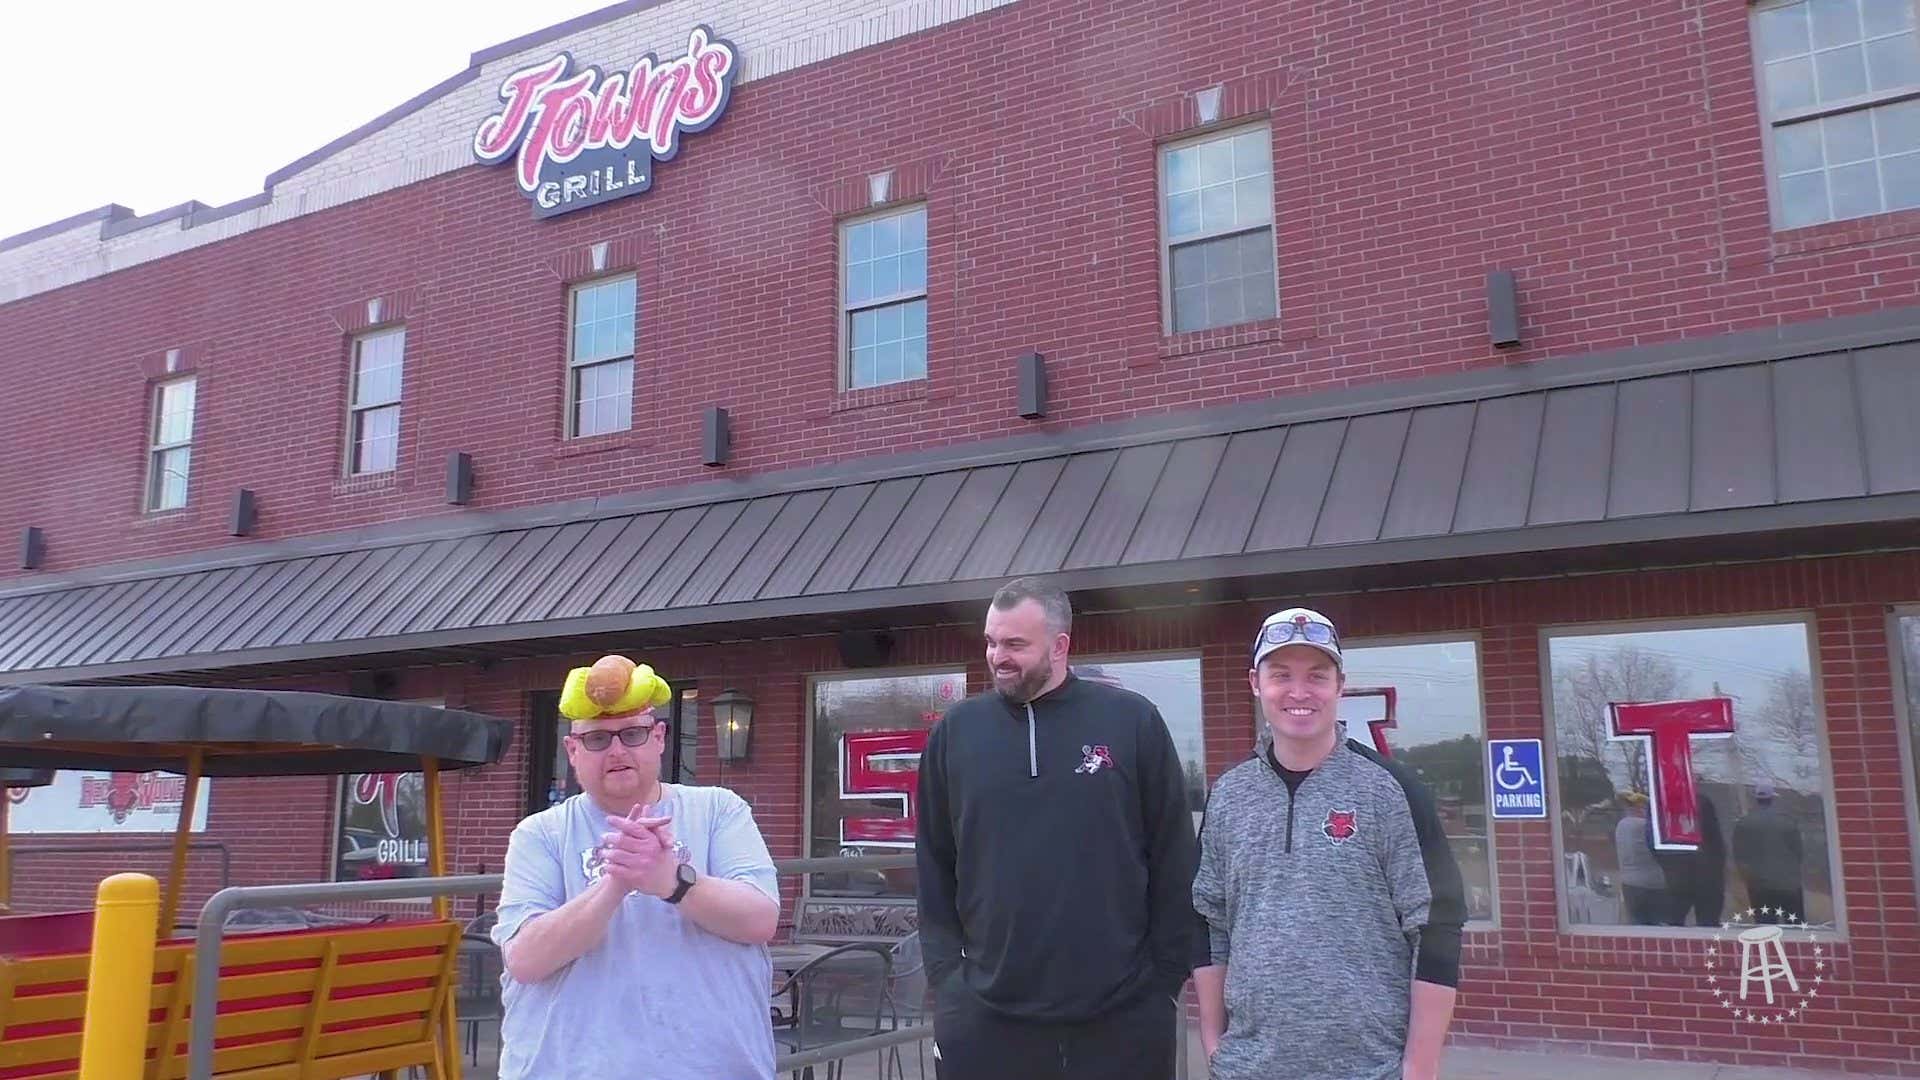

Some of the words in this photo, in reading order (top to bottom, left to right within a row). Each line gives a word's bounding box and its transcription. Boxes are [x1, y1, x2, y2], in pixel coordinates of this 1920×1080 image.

[537, 160, 645, 209] GRILL
[1604, 697, 1736, 850] T
[1496, 794, 1541, 809] PARKING
[378, 839, 427, 863] GRILL
